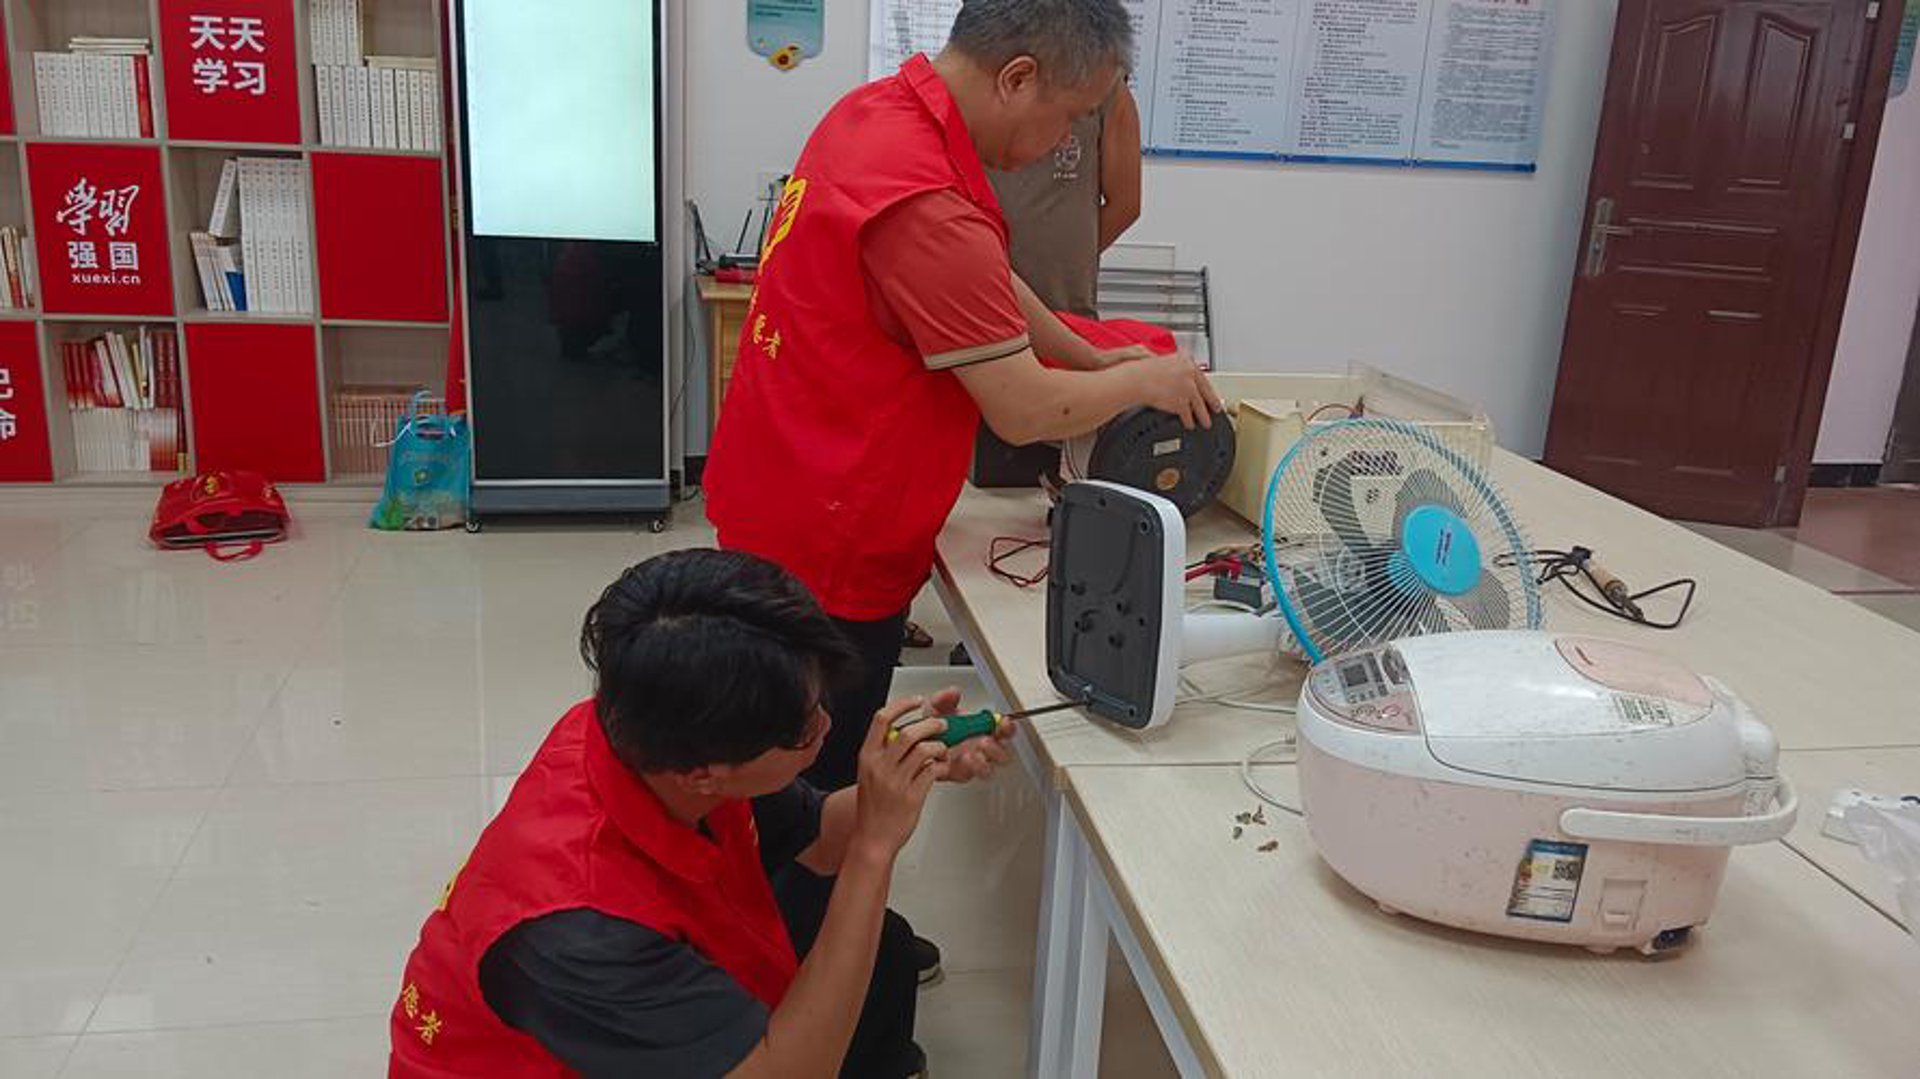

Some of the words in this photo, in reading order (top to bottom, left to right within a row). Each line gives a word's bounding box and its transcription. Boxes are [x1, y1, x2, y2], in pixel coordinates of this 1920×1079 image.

[190, 15, 265, 53] 天天
[193, 58, 266, 95] 学习
[67, 241, 139, 269] 强国
[72, 271, 141, 285] xuexi.cn
